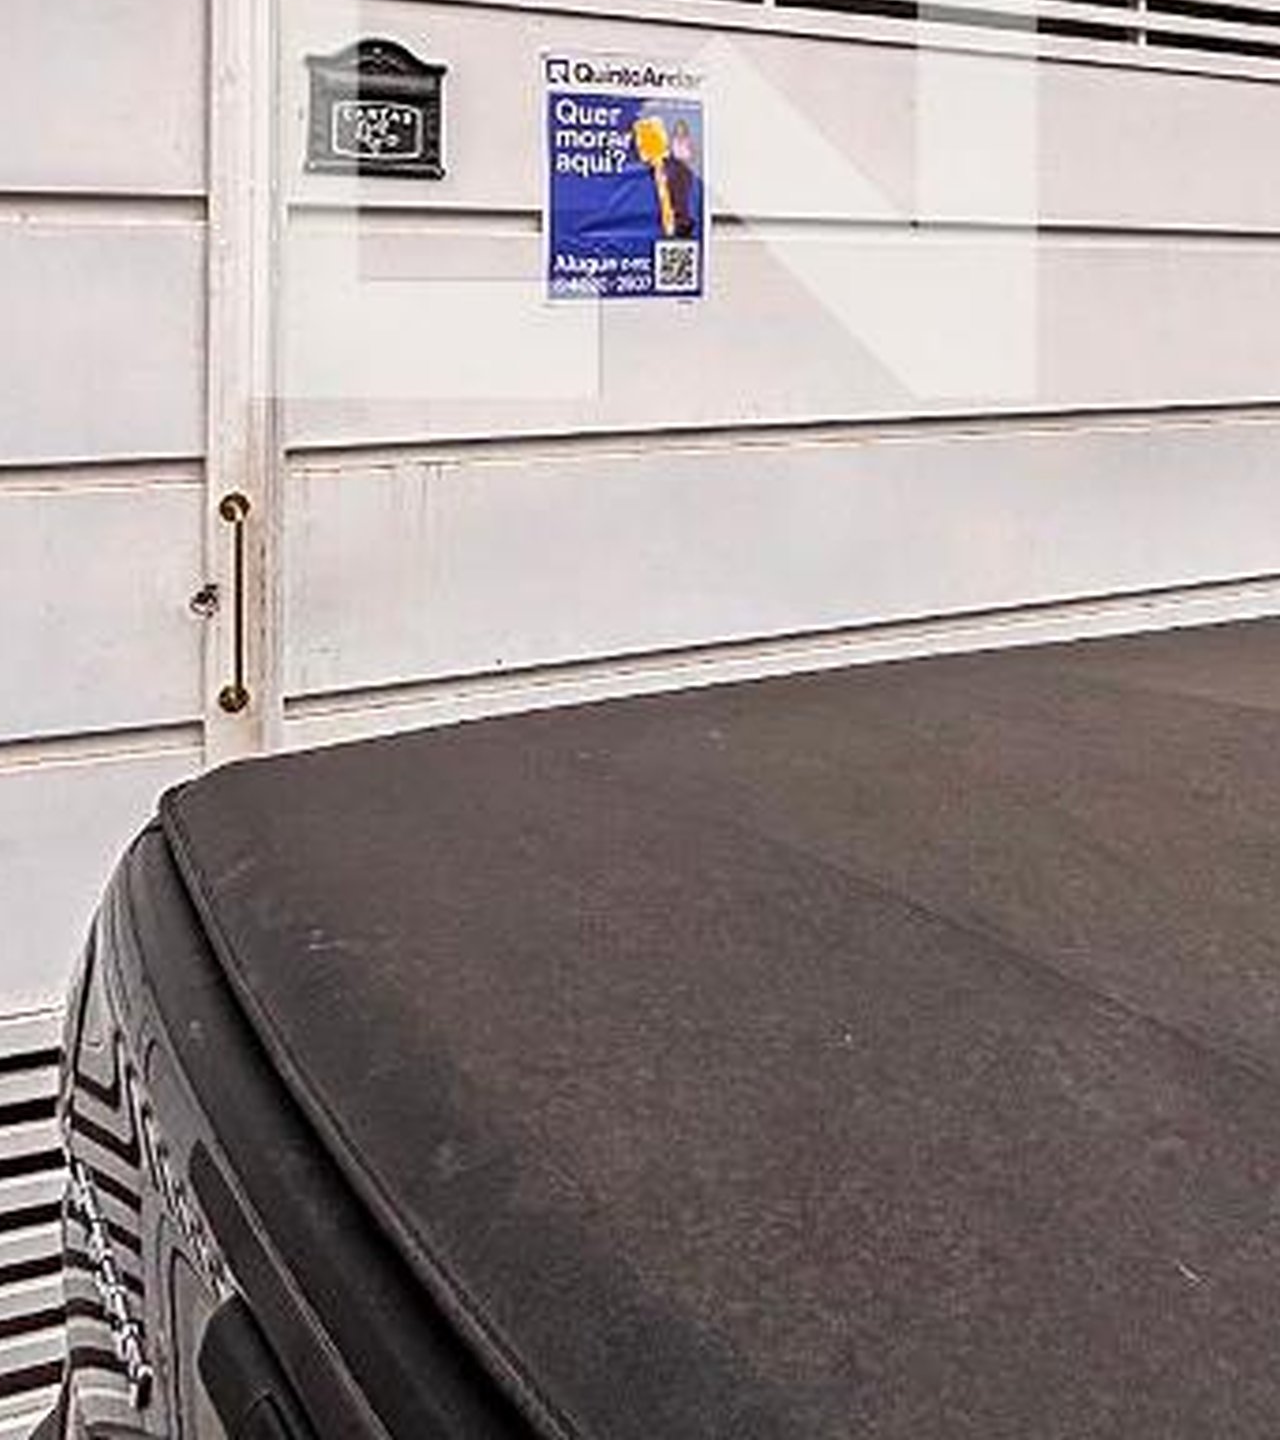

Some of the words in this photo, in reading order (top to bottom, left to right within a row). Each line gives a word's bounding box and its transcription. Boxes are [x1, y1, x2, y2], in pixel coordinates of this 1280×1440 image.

[555, 98, 622, 126] Quer
[555, 129, 633, 150] morar
[555, 149, 628, 178] aqui?
